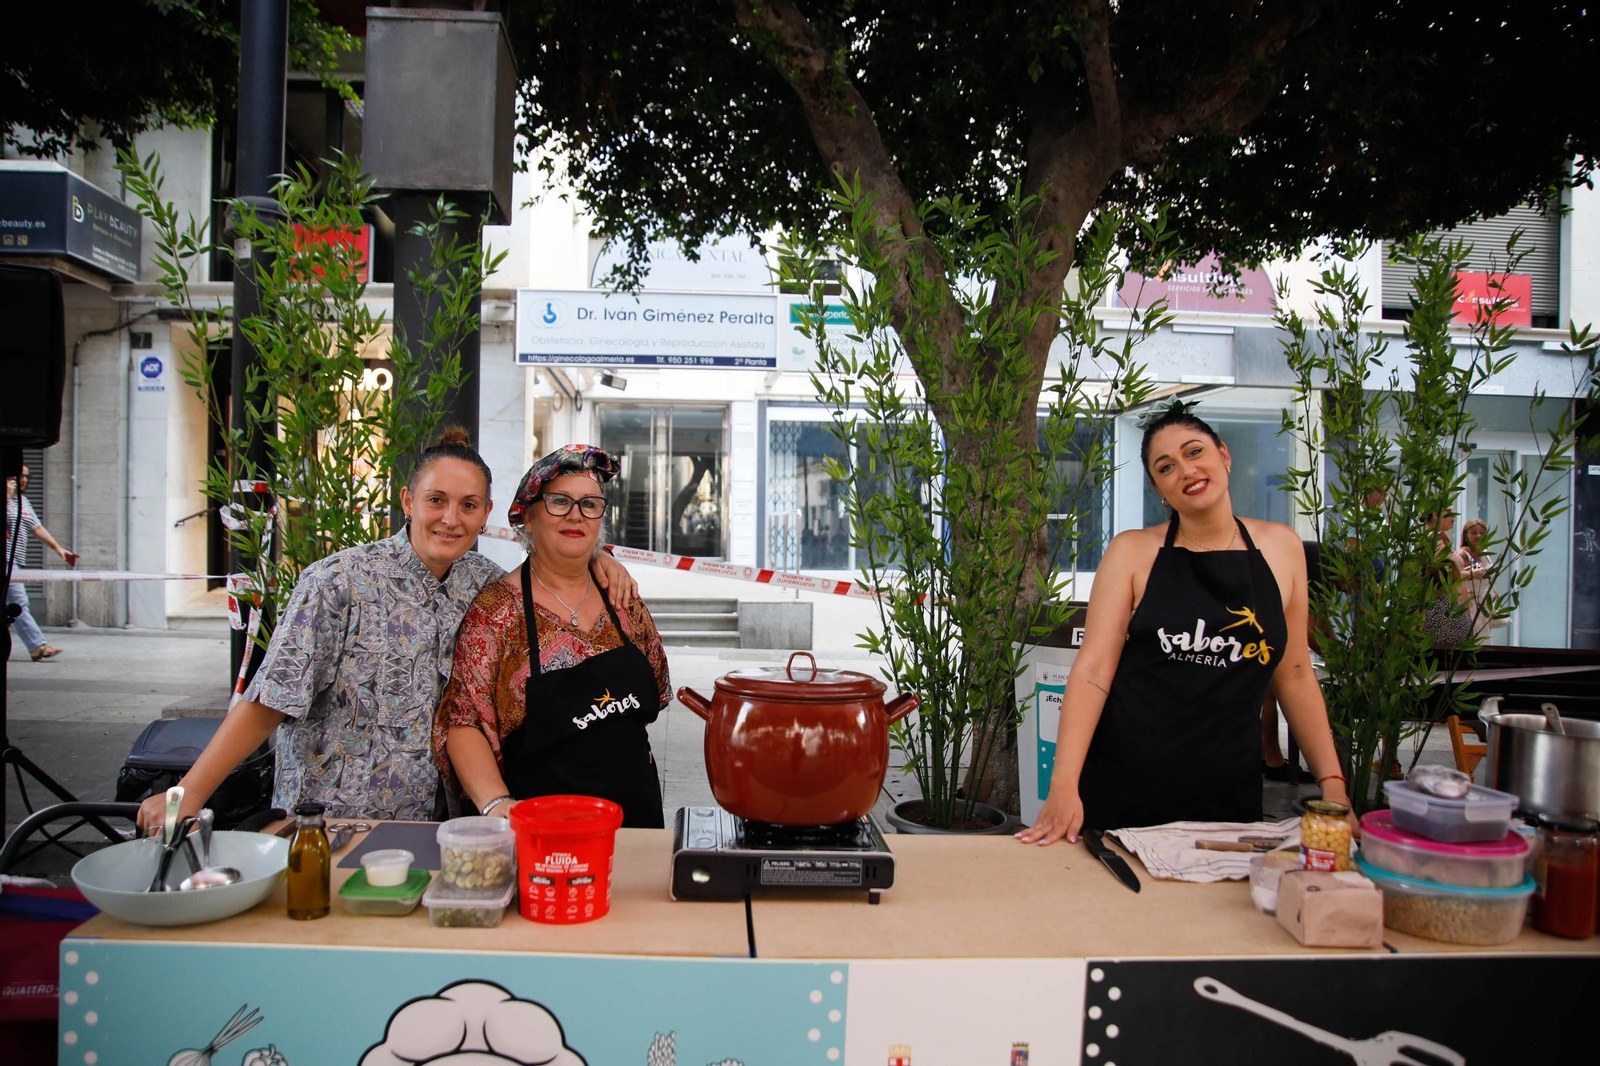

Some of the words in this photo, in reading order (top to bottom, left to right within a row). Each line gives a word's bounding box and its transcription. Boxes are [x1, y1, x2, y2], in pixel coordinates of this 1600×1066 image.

[0, 219, 46, 229] beauty.es
[87, 203, 108, 222] PLAY
[109, 214, 138, 238] BEAUTY
[1167, 284, 1200, 293] SERVICIOS
[577, 307, 597, 320] Dr.
[604, 307, 637, 321] Iván
[643, 308, 714, 323] Giménez
[720, 310, 774, 325] Peralta
[138, 333, 146, 348] 7
[531, 335, 586, 346] Obstetricia,
[651, 340, 658, 348] y
[730, 340, 765, 350] Asistida
[668, 356, 682, 364] 950
[143, 362, 161, 372] ADT
[616, 552, 657, 563] AYUNTAMIENTO
[697, 565, 737, 576] AYUNTAMIENTO
[776, 577, 816, 588] AYUNTAMIENTO
[1157, 618, 1274, 665] sabores
[572, 693, 641, 730] sabores
[545, 856, 578, 866] FLUIDA
